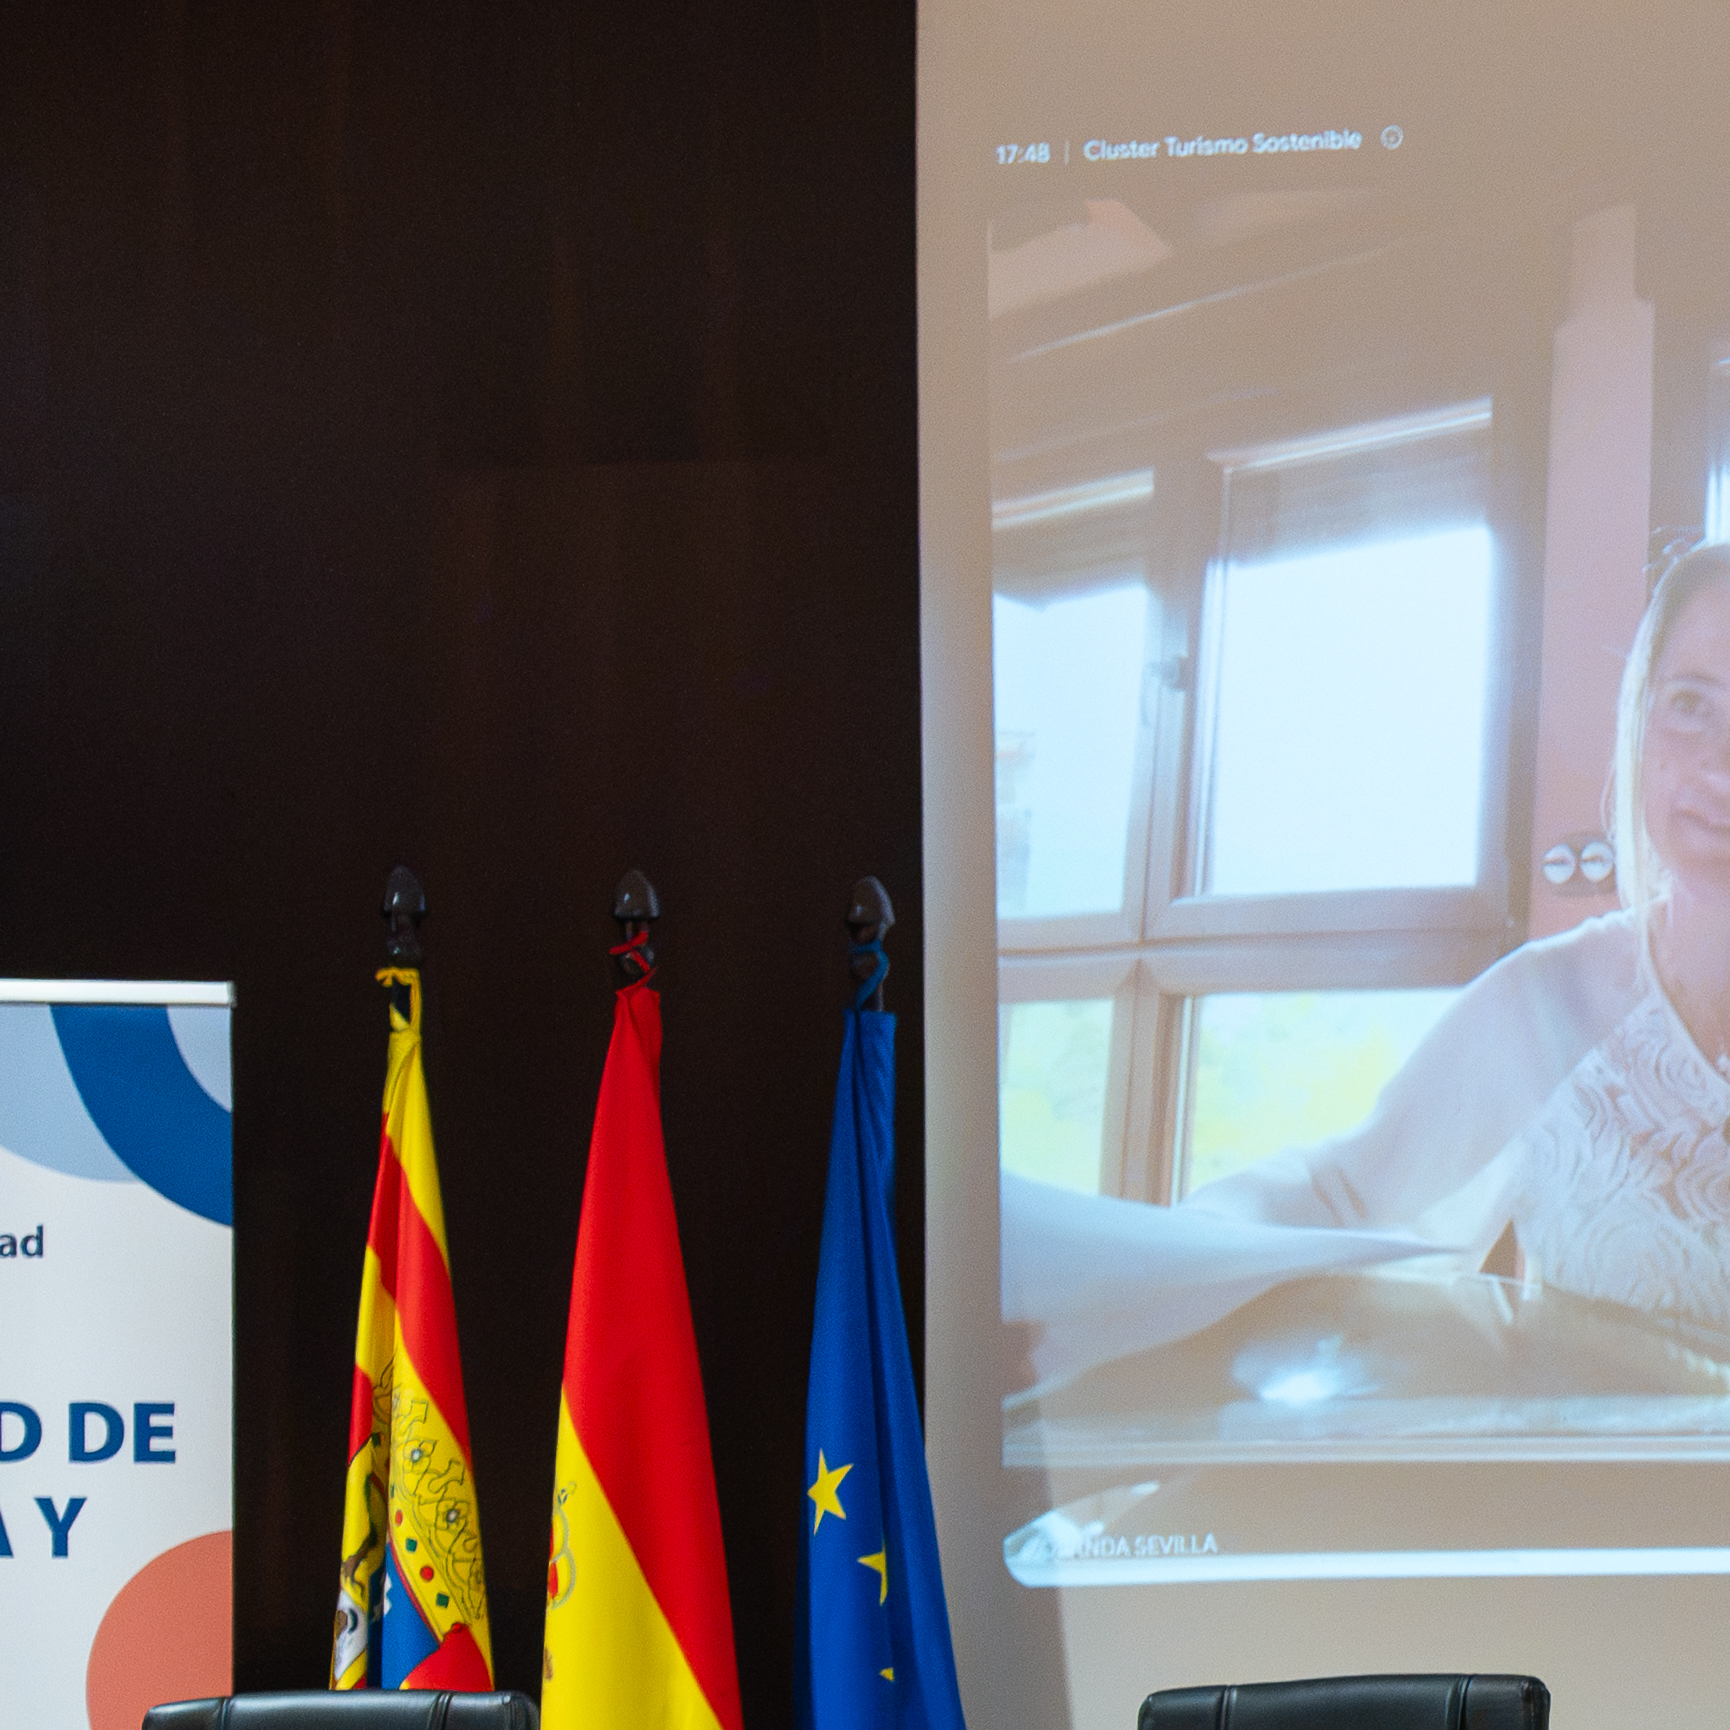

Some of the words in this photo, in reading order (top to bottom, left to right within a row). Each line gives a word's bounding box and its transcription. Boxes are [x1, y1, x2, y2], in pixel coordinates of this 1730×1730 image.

[995, 143, 1051, 164] 17:48
[1084, 139, 1159, 162] Cluster
[1165, 135, 1249, 157] Turismo
[1252, 129, 1363, 154] Sostenible
[67, 1402, 177, 1464] DE
[33, 1497, 88, 1559] Y
[1134, 1531, 1219, 1556] SEVILLA
